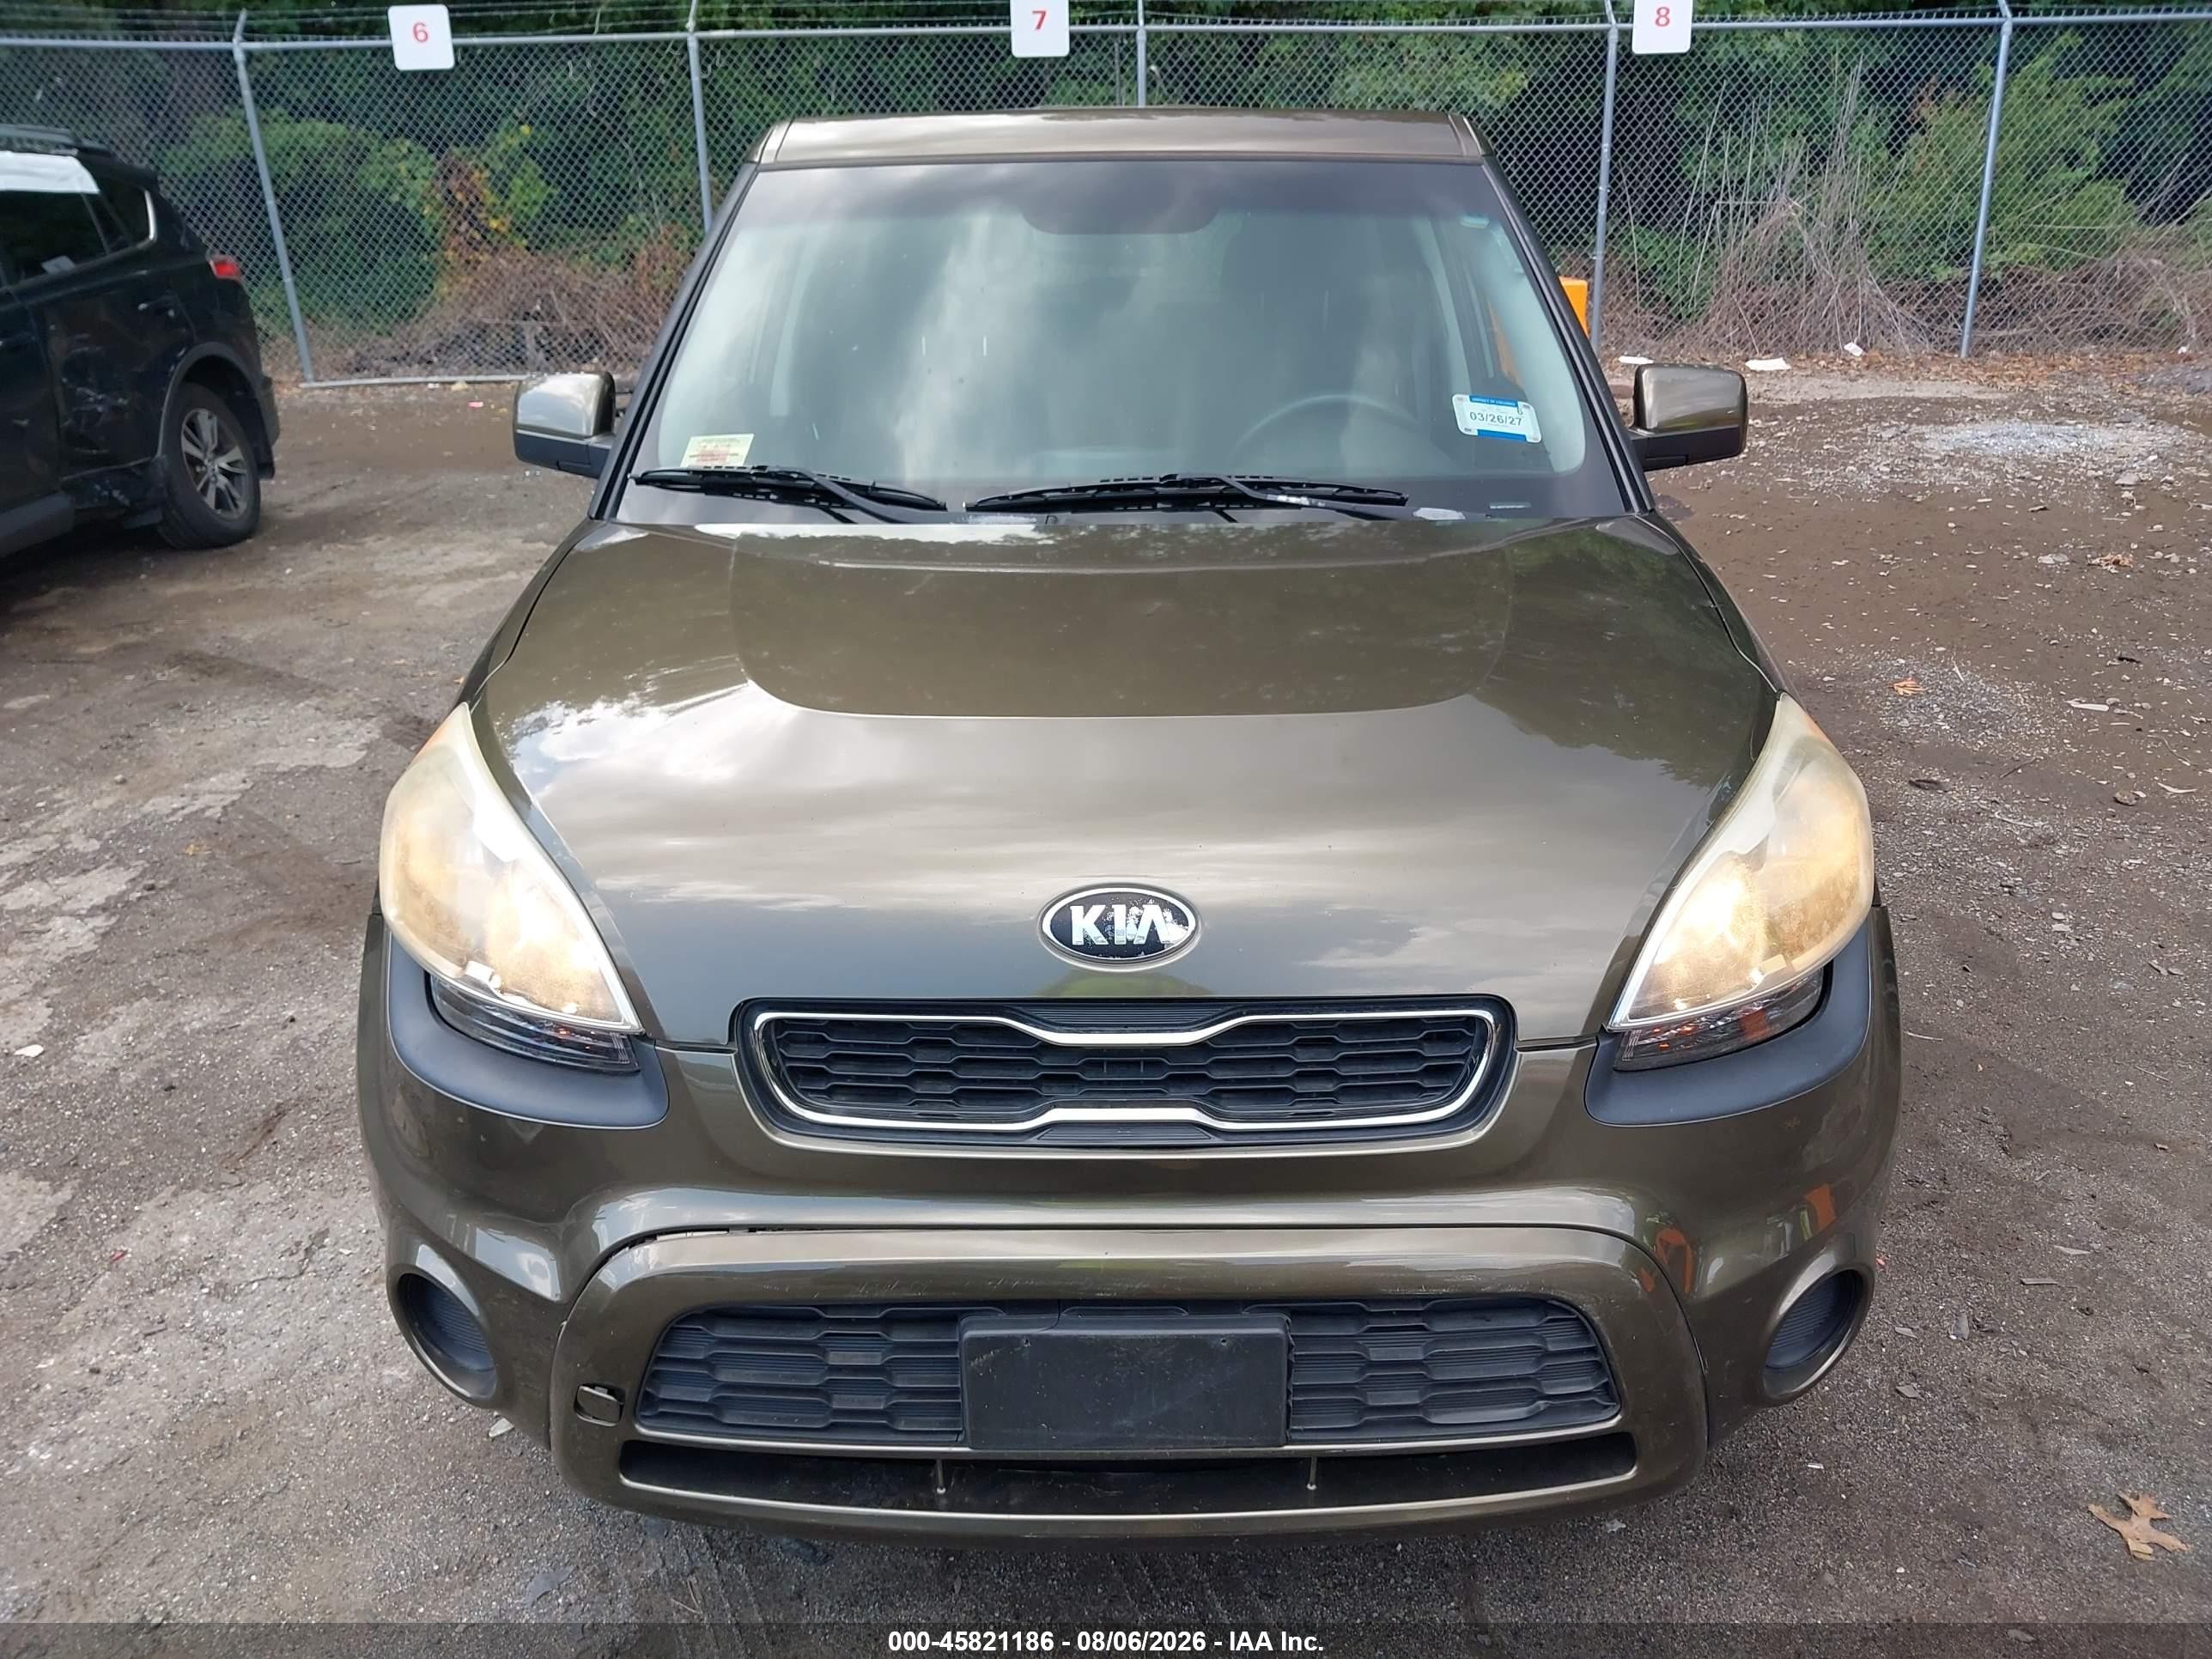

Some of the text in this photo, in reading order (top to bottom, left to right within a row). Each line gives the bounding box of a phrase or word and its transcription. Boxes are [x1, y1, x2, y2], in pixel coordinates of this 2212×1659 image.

[1032, 10, 1047, 30] 7
[1655, 6, 1670, 27] 8
[413, 22, 428, 43] 6
[1469, 411, 1523, 427] 03/26/27
[1070, 903, 1171, 945] KIA
